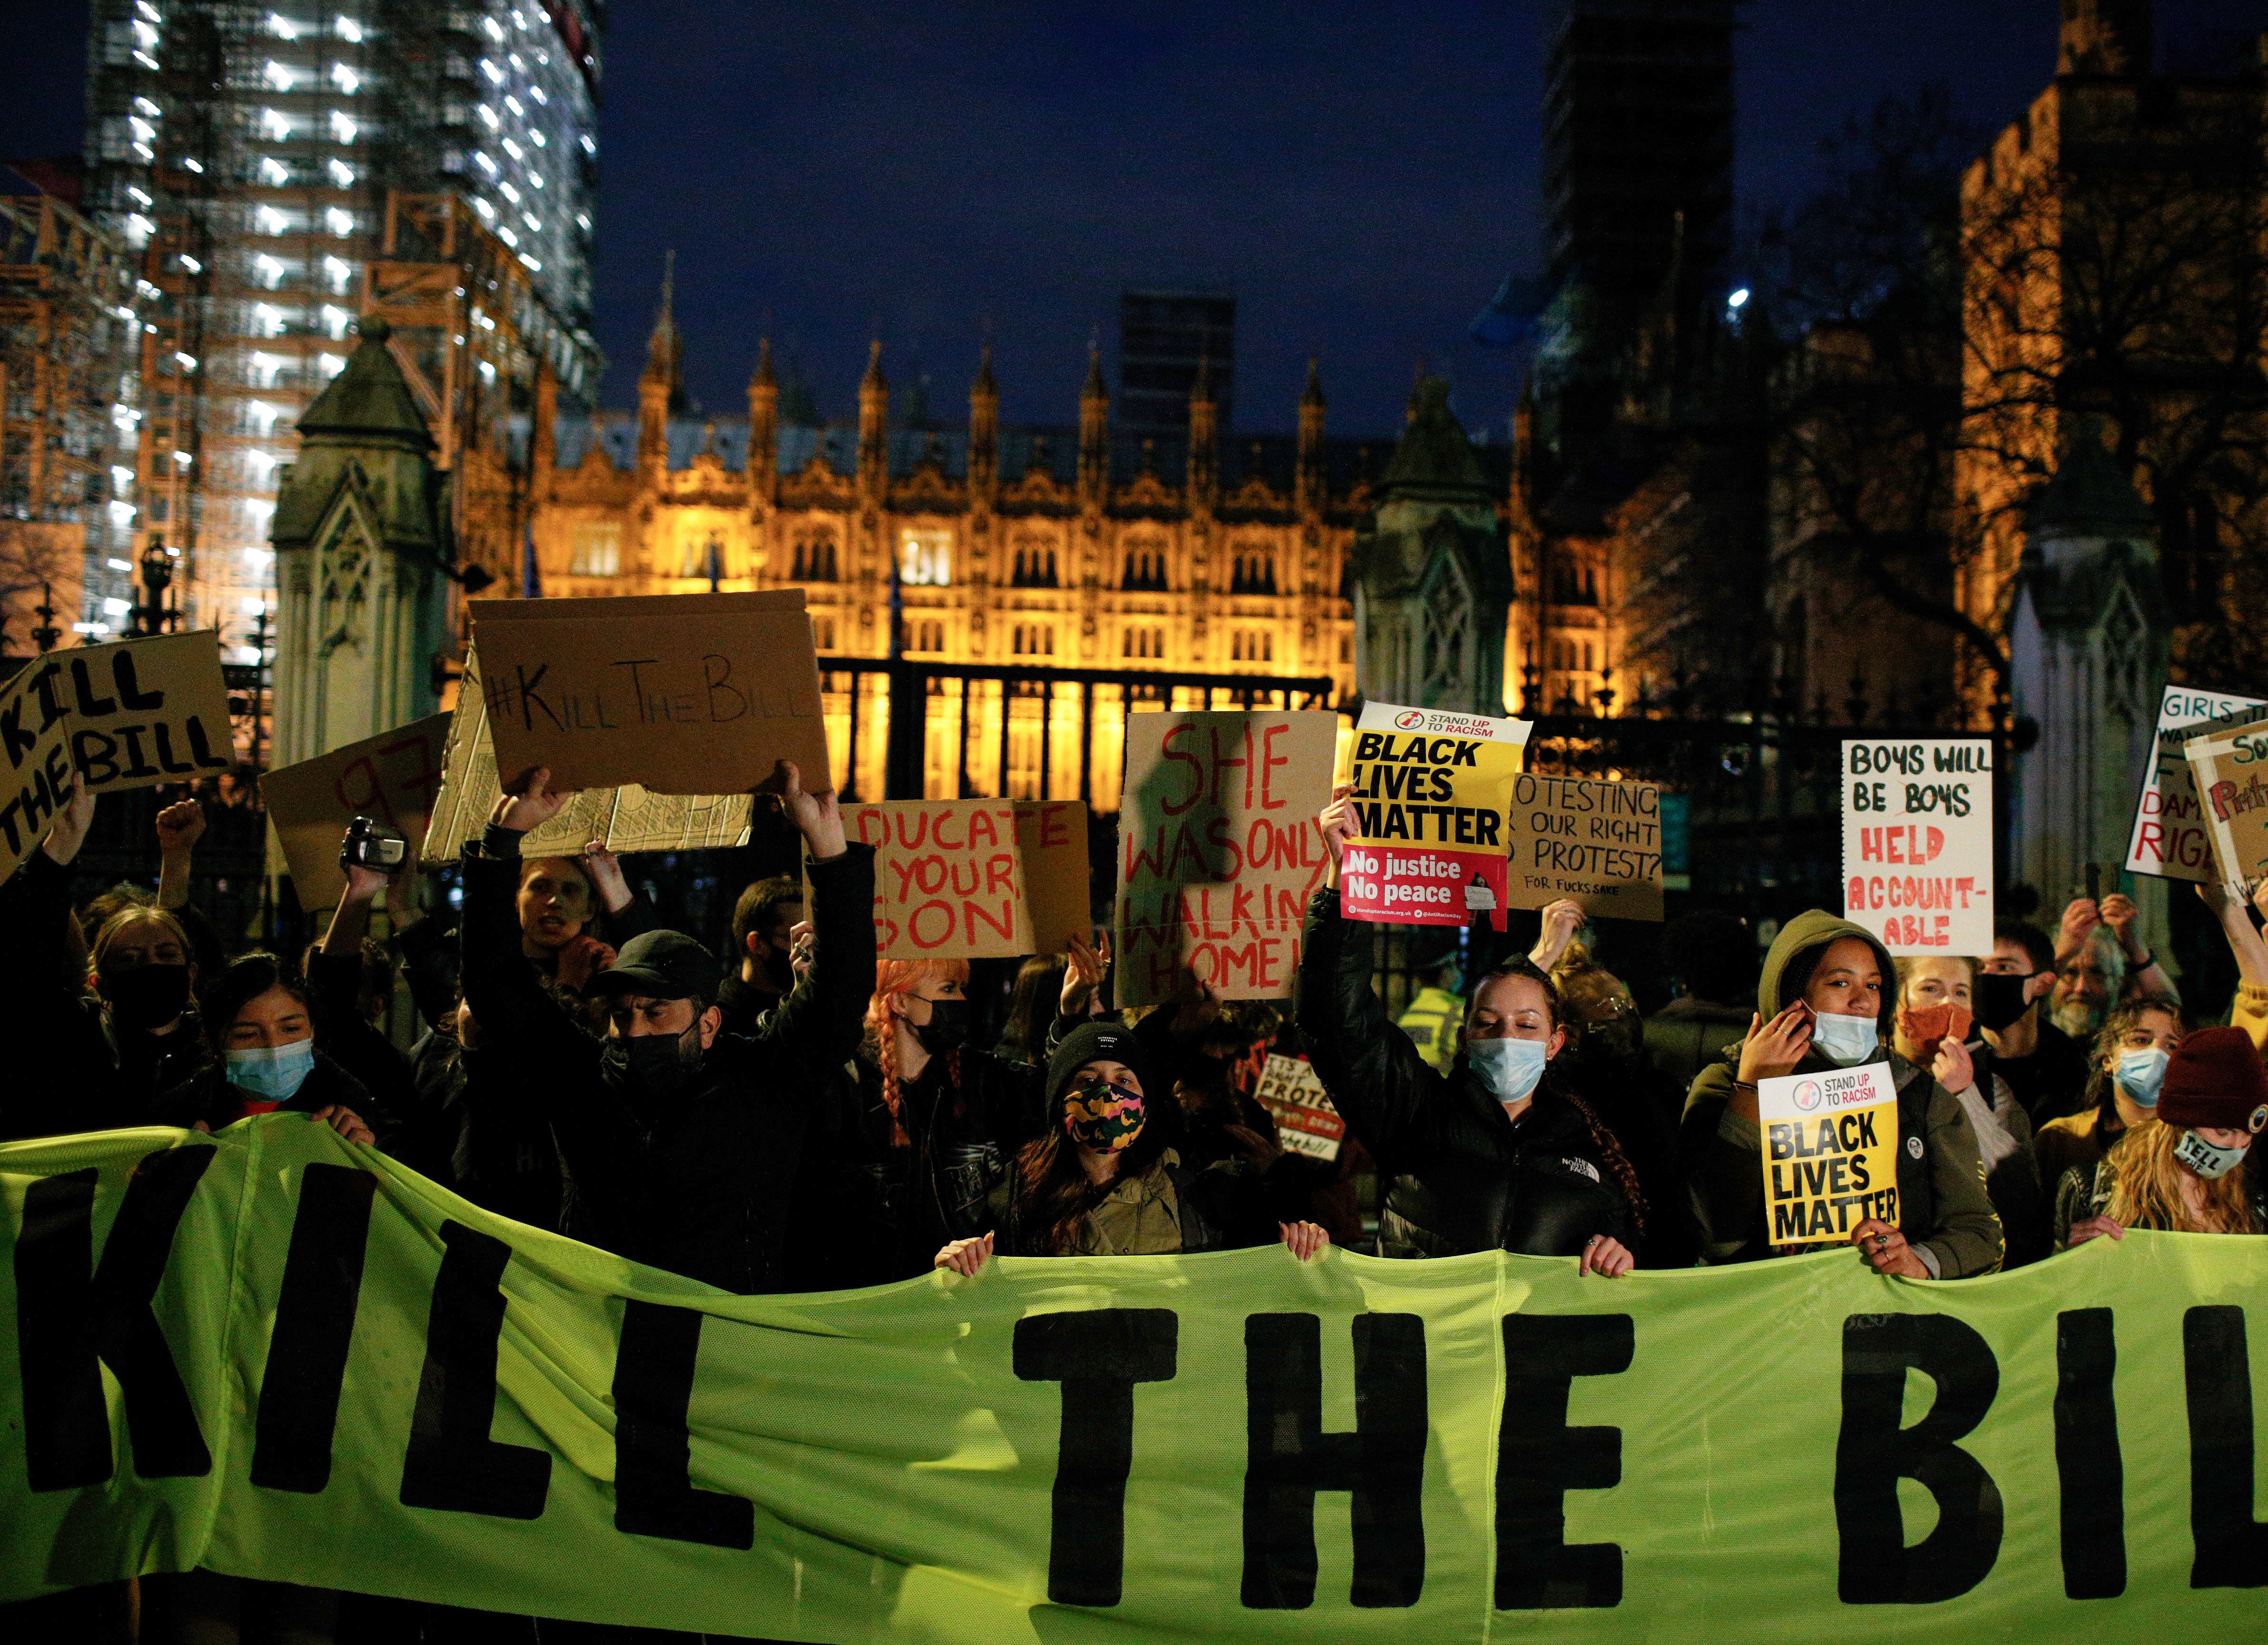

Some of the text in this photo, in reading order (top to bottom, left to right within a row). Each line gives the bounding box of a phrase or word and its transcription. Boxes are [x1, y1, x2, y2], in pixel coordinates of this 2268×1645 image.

[0, 649, 165, 770] KILL
[1430, 714, 1490, 728] STAND UP
[2165, 694, 2232, 723] GIRLS
[1428, 723, 1493, 737] TO RACISM
[1161, 720, 1289, 815] SHE
[1355, 733, 1483, 767] BLACK
[1850, 744, 1992, 775] BOYS WILL
[0, 715, 229, 856] THE BILL
[1350, 763, 1454, 802] LIVES
[1515, 775, 1658, 818] OTESTING
[1853, 782, 1971, 817] BE BOYS
[1352, 802, 1501, 846] MATTER
[2143, 792, 2201, 821] DAM
[839, 805, 1070, 850] DUCATE
[1532, 812, 1577, 837] OUR
[1591, 817, 1658, 846] RIGHT
[1860, 825, 1945, 865] HELD
[1125, 817, 1330, 892] WAS ONLY
[1349, 850, 1461, 880] No justice
[1535, 839, 1661, 881] PROTEST?
[889, 853, 1021, 903] YOUR
[1348, 875, 1378, 900] No
[1383, 883, 1452, 906] peace
[1525, 875, 1551, 889] FOR
[1557, 879, 1590, 894] FUCKS
[1848, 875, 1987, 910] ACCOUNT-
[1124, 882, 1323, 954] WALKIN
[1356, 908, 1411, 916] standuptoracism.org.uk
[1883, 915, 1950, 947] ABLE
[1825, 1074, 1870, 1092] STAND UP
[1826, 1086, 1876, 1106] TO RACISM
[1769, 1111, 1879, 1160] BLACK
[2184, 1135, 2220, 1170] TELL
[1562, 1158, 1589, 1171] NORTH
[1570, 1166, 1590, 1177] FACE
[1574, 1157, 1589, 1166] THE
[1771, 1154, 1870, 1201] LIVES
[1774, 1187, 1897, 1240] MATTER
[13, 1144, 2268, 1610] KILL THE BIL
